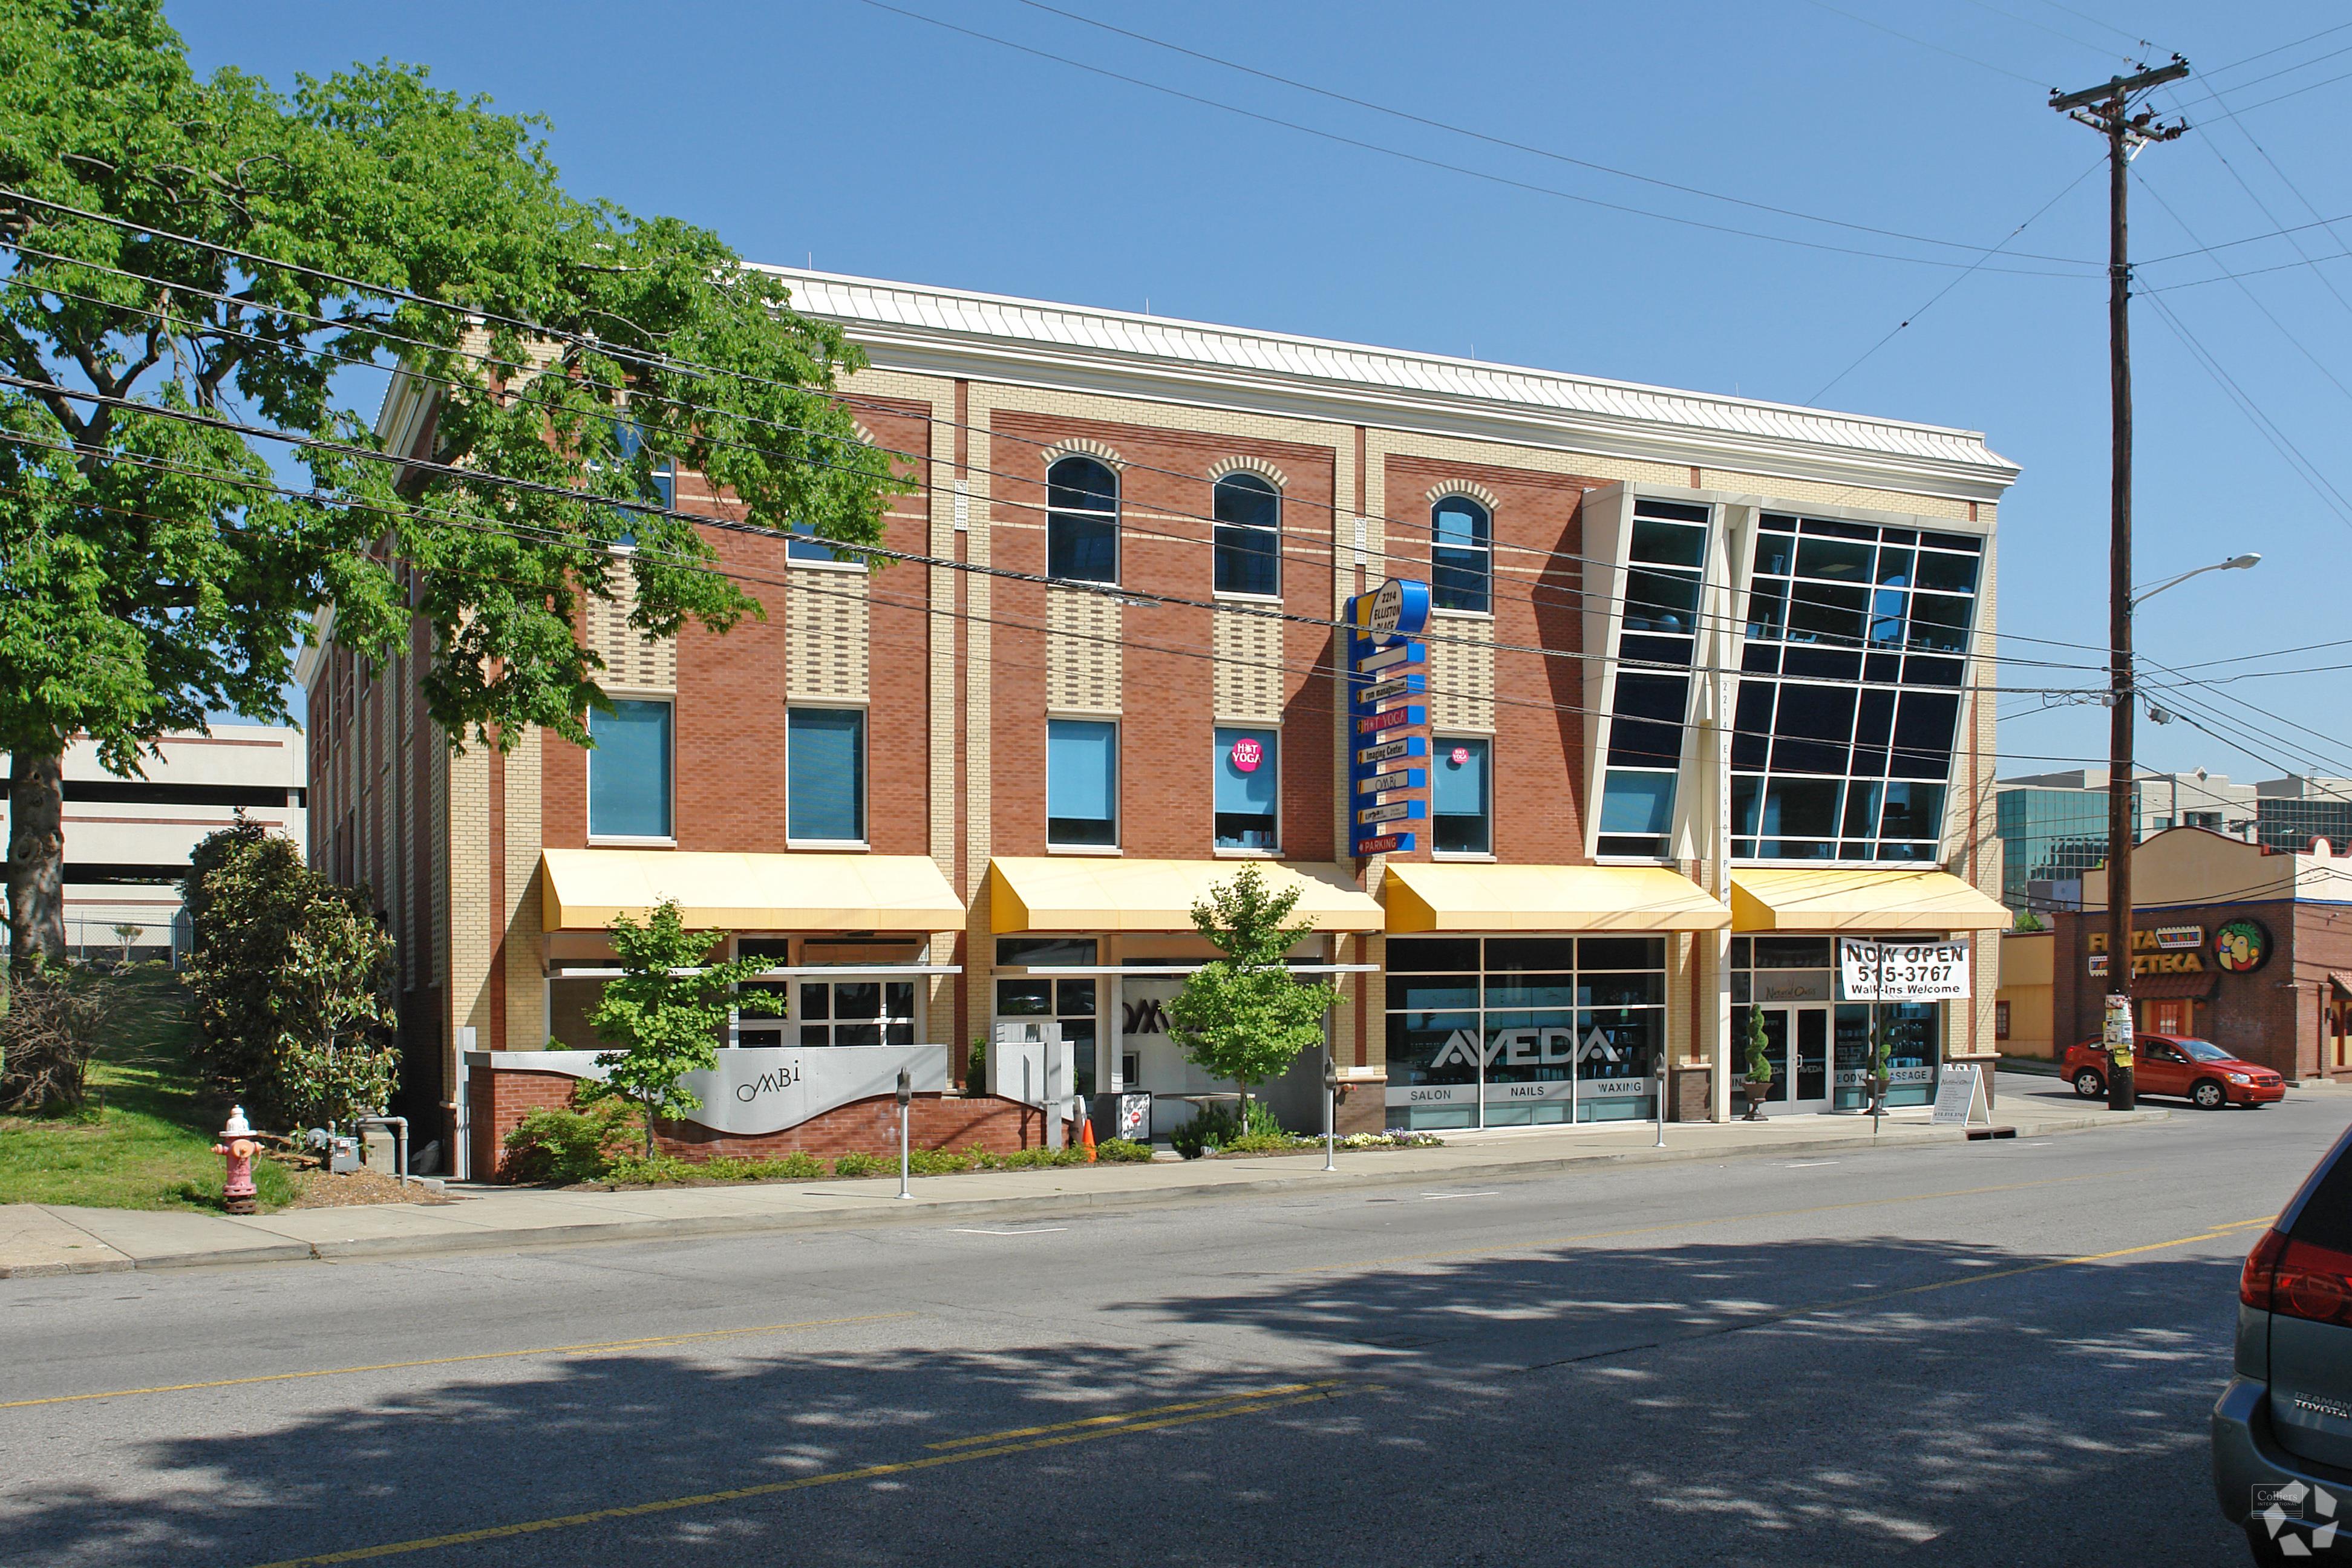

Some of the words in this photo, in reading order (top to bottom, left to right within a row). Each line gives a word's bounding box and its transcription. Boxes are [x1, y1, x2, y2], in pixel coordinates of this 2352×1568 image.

[1382, 590, 1397, 603] 2214
[1374, 605, 1401, 620] ELLISTON
[1382, 710, 1404, 725] YOGA
[1232, 752, 1262, 763] YOGA
[1367, 748, 1385, 760] Imaging
[1387, 744, 1403, 755] Center
[1365, 838, 1396, 852] PARKING
[2089, 930, 2159, 952] FITA
[1847, 944, 1898, 962] NOW
[1904, 945, 1963, 962] OPEN
[2132, 953, 2204, 973] ZTECA
[1908, 984, 1960, 994] Welcome
[1430, 1025, 1621, 1068] AVEDA
[1798, 1065, 1824, 1074] AVEDA
[1837, 1073, 1864, 1083] BODY
[1890, 1071, 1927, 1082] ASSAGE
[1511, 1086, 1544, 1096] NAILS
[1598, 1082, 1641, 1093] WAXING
[1411, 1090, 1451, 1100] SALON
[2295, 1399, 2348, 1417] TOYOTA
